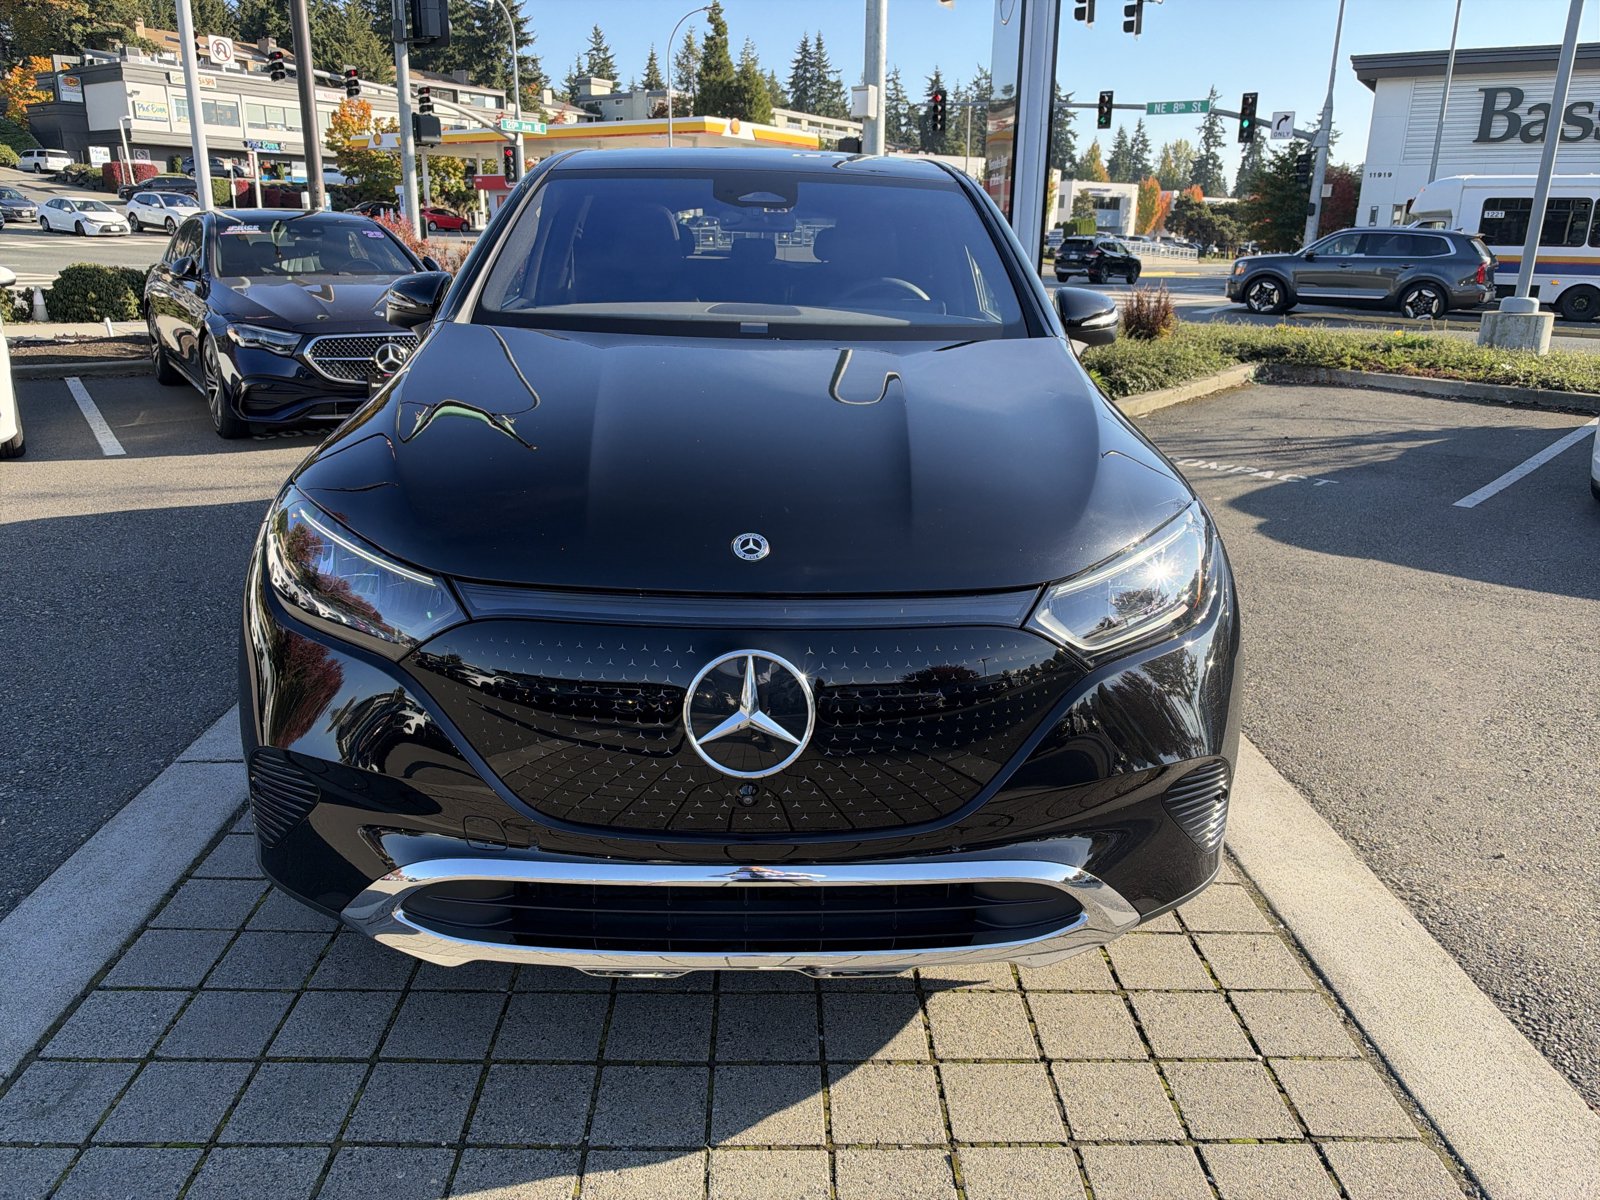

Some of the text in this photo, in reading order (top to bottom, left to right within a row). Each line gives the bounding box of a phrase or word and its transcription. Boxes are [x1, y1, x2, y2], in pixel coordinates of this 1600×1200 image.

[1154, 101, 1202, 114] NE 8th St
[1472, 87, 1600, 143] Bas
[1168, 455, 1339, 486] OMPACT
